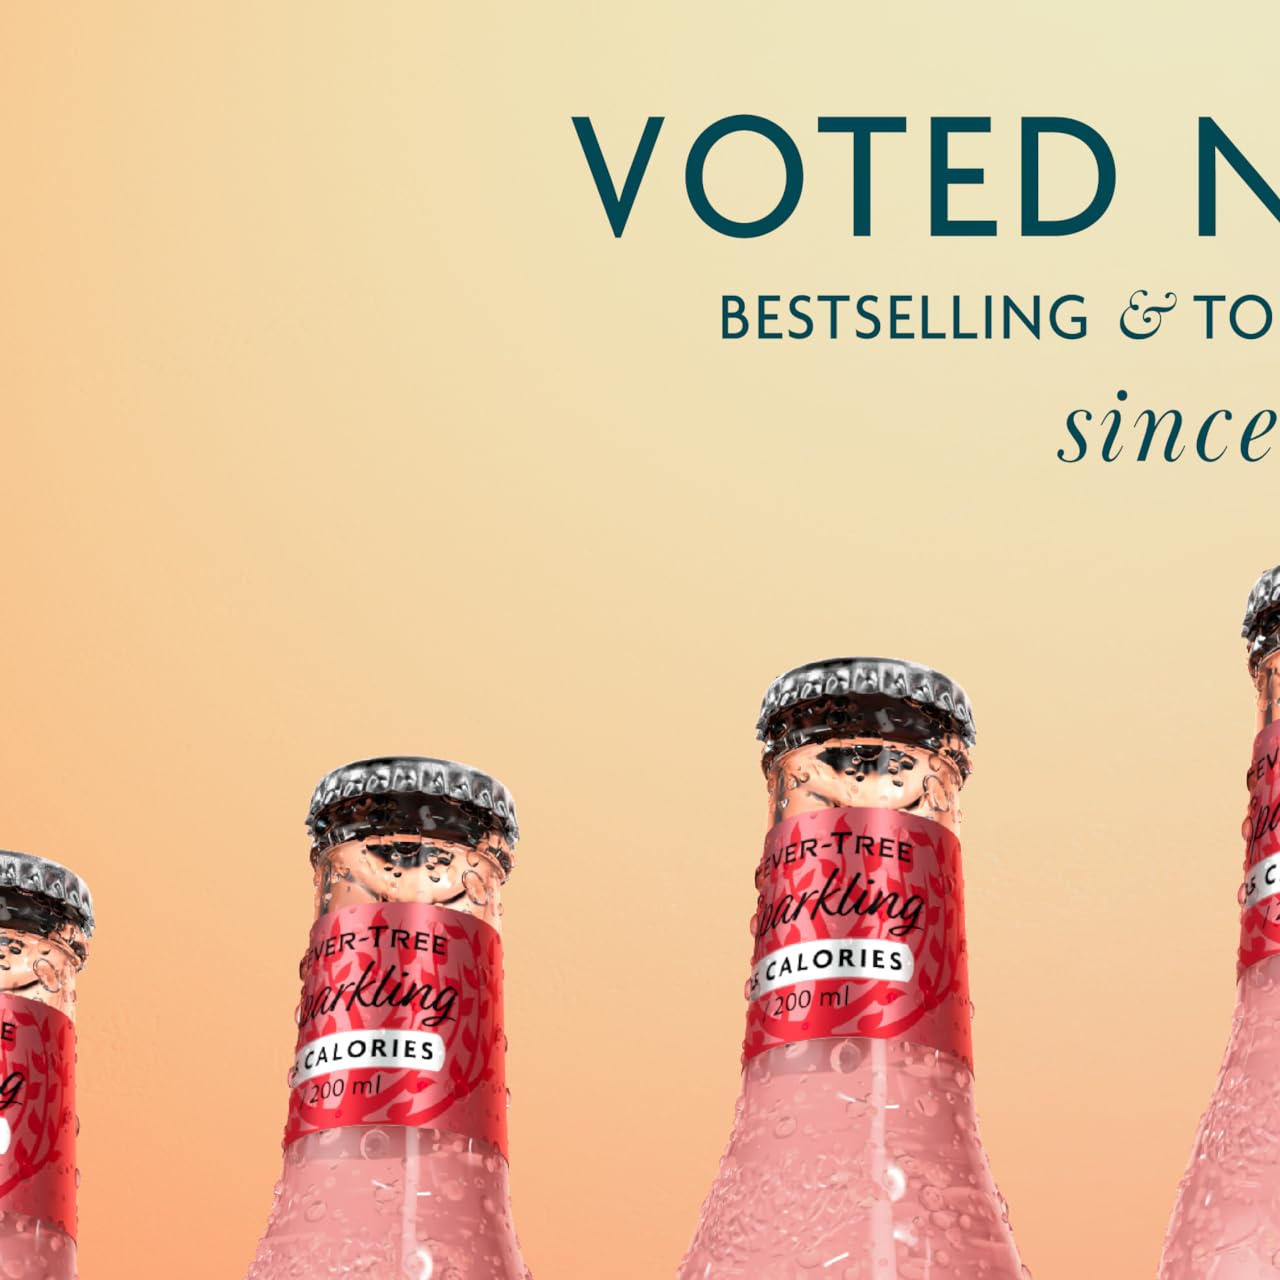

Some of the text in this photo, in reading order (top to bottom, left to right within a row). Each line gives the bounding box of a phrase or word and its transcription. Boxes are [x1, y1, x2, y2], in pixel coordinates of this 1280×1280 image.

[766, 949, 903, 981] CALORIES
[773, 985, 849, 1016] 200 ml
[305, 1039, 433, 1070] CALORIES
[310, 1075, 381, 1103] 200 ml
